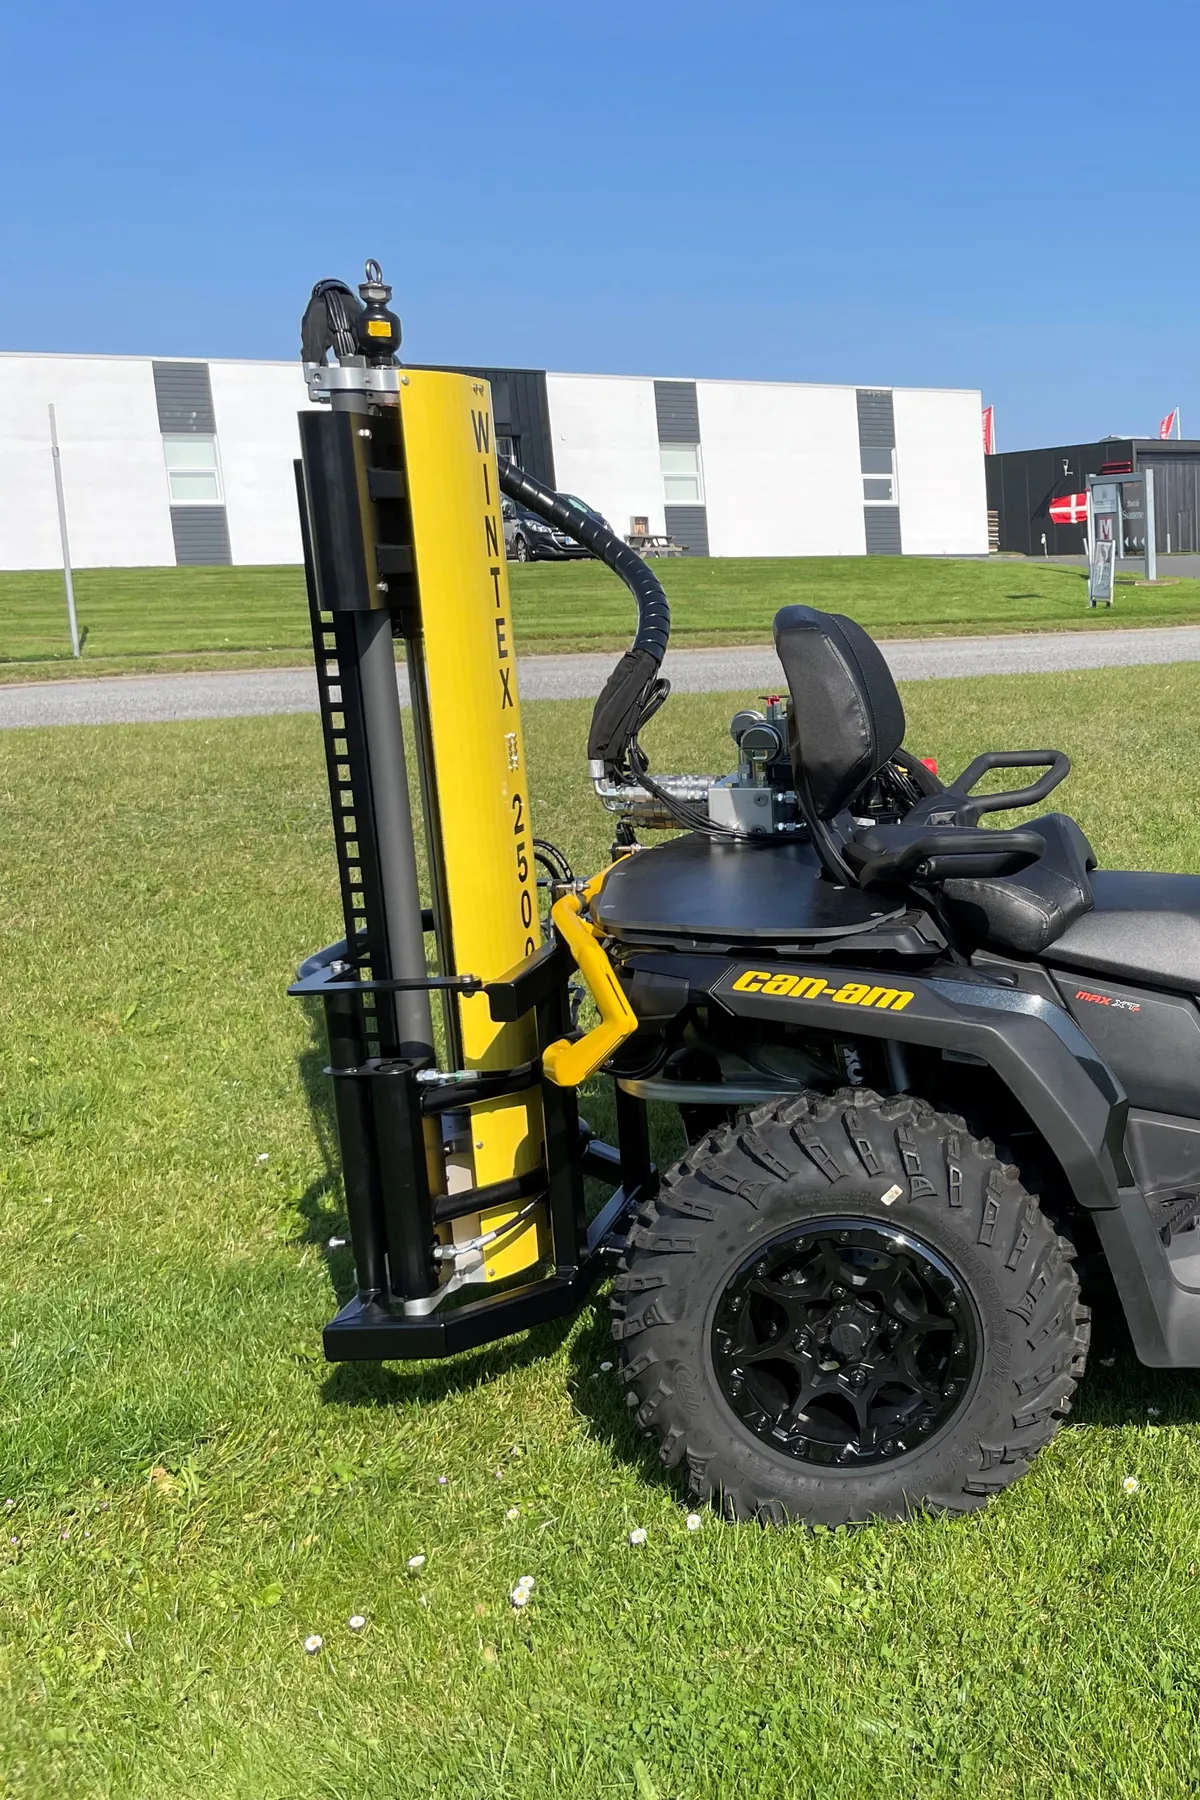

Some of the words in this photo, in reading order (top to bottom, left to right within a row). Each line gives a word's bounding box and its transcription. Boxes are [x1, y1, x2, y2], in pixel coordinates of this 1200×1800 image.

[471, 409, 515, 710] WINTEX
[731, 970, 915, 1011] can-am
[1075, 990, 1113, 1006] MAX
